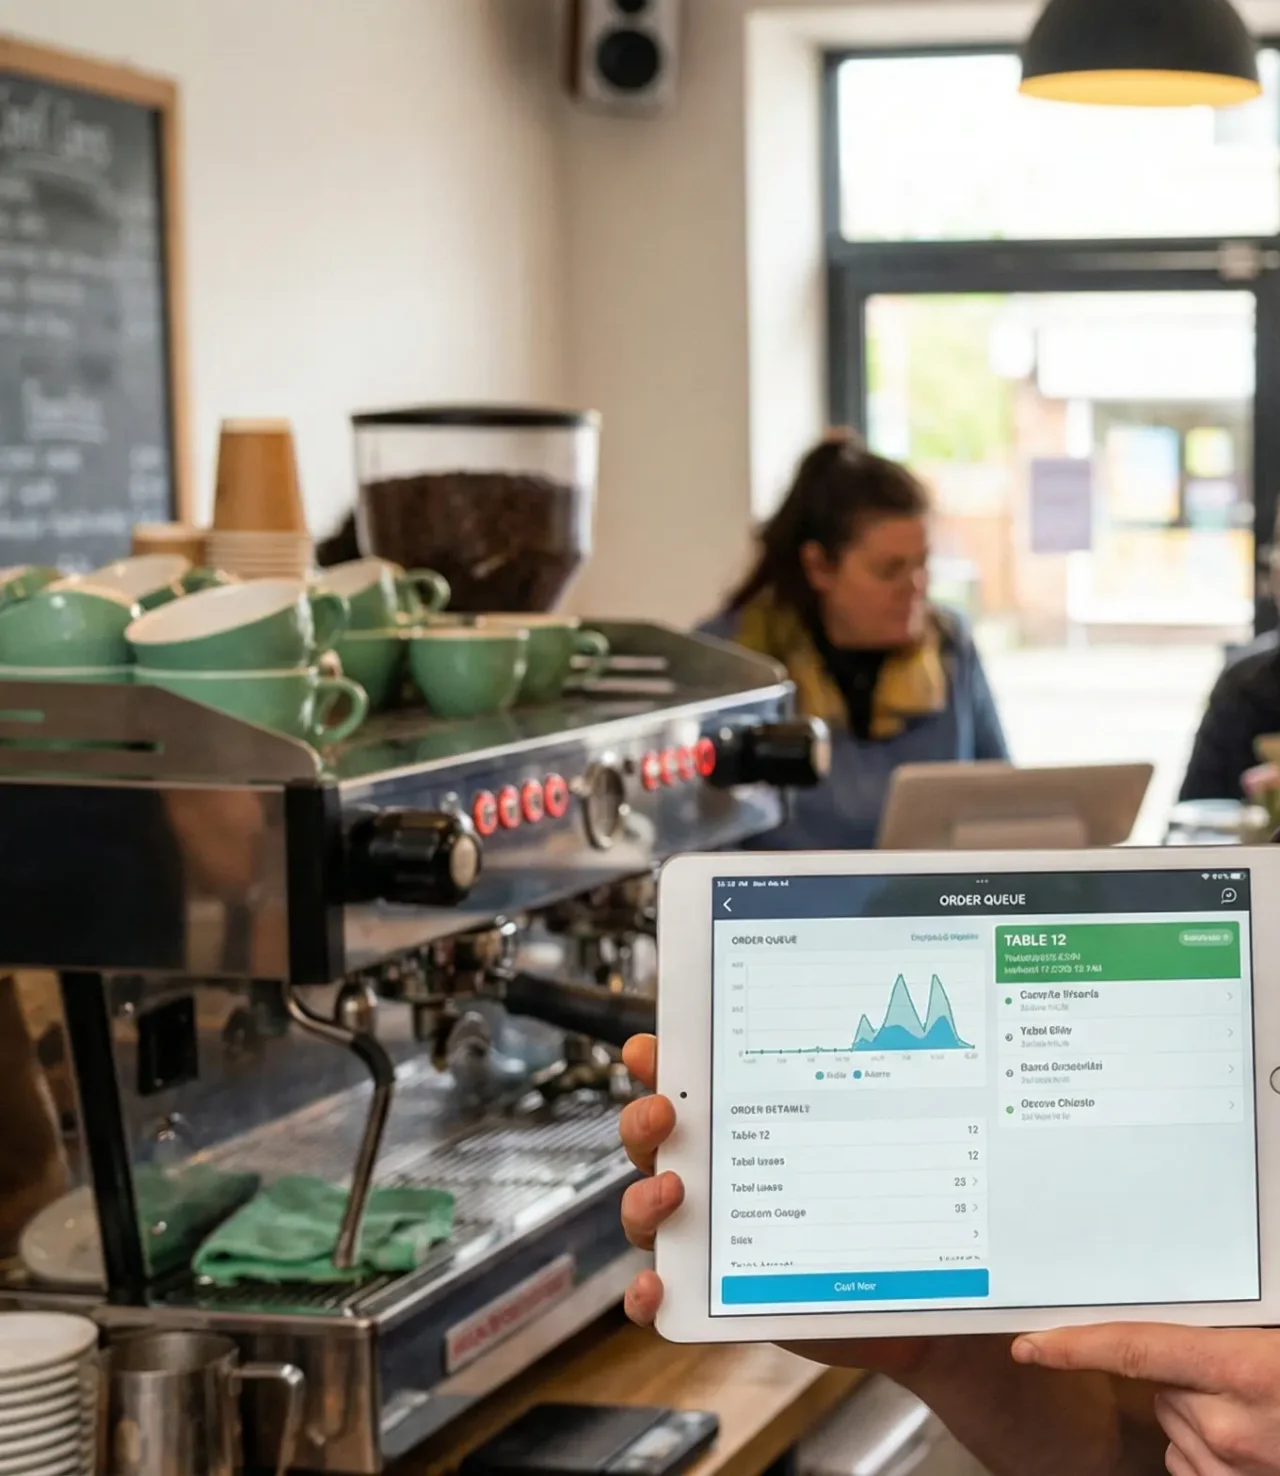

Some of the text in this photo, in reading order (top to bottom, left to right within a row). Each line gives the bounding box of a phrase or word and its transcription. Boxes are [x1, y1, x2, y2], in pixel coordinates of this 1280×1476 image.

[940, 893, 1026, 906] ORDER QUEUE
[731, 935, 797, 945] ORDER QUEUE
[1004, 934, 1067, 947] TABLE 12
[731, 1106, 764, 1115] ORDER
[967, 1125, 979, 1135] 12
[731, 1131, 757, 1141] Table
[967, 1151, 979, 1161] 12
